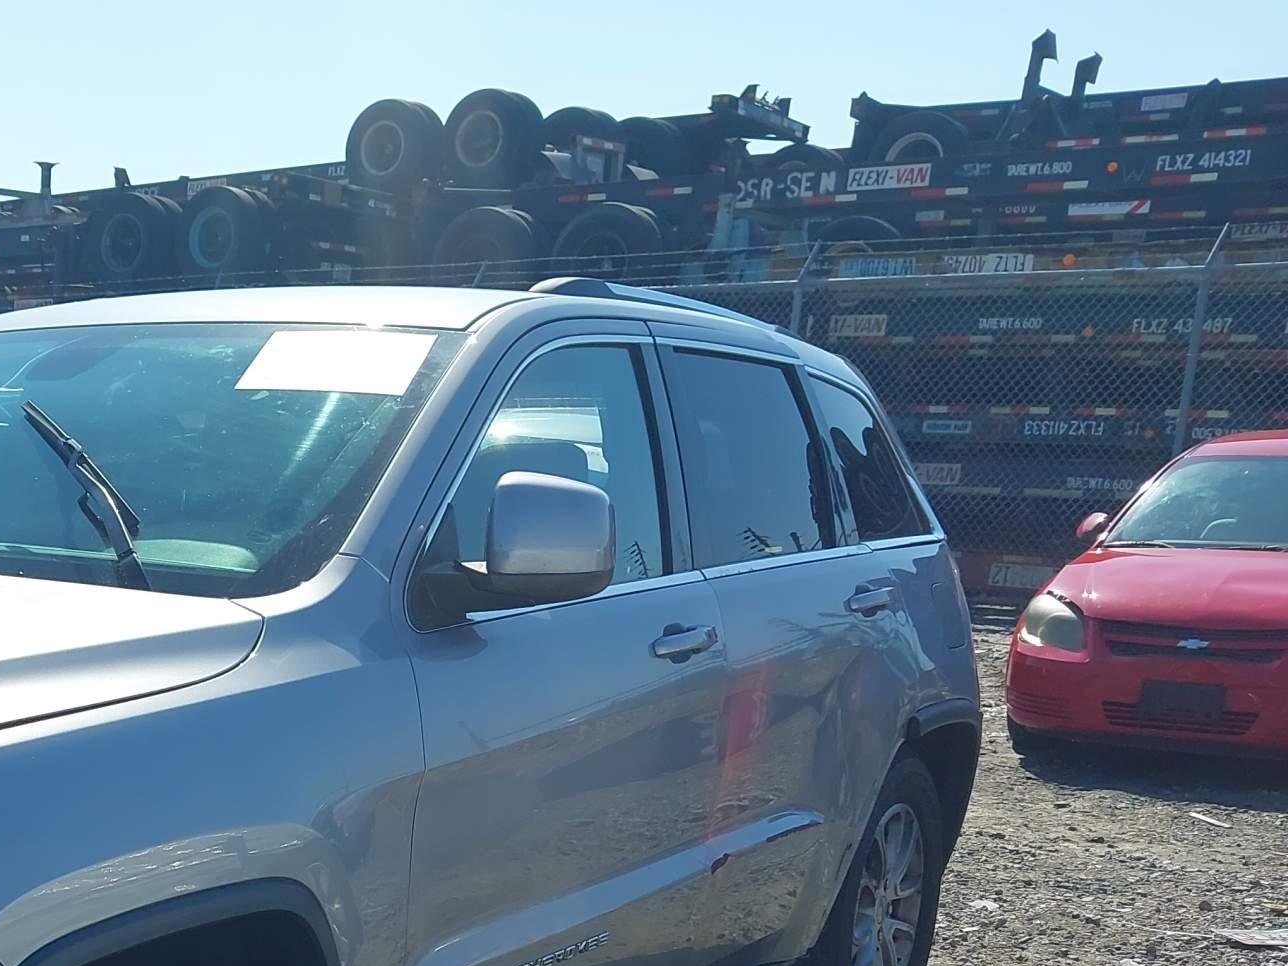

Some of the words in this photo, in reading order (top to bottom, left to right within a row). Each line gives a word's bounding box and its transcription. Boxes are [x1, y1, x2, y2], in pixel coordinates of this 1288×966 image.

[1155, 154, 1194, 171] FLXZ
[1198, 149, 1252, 168] 414321
[849, 166, 929, 188] FLEXI-VAN
[1132, 318, 1169, 333] FLXZ
[1174, 318, 1233, 333] 43487
